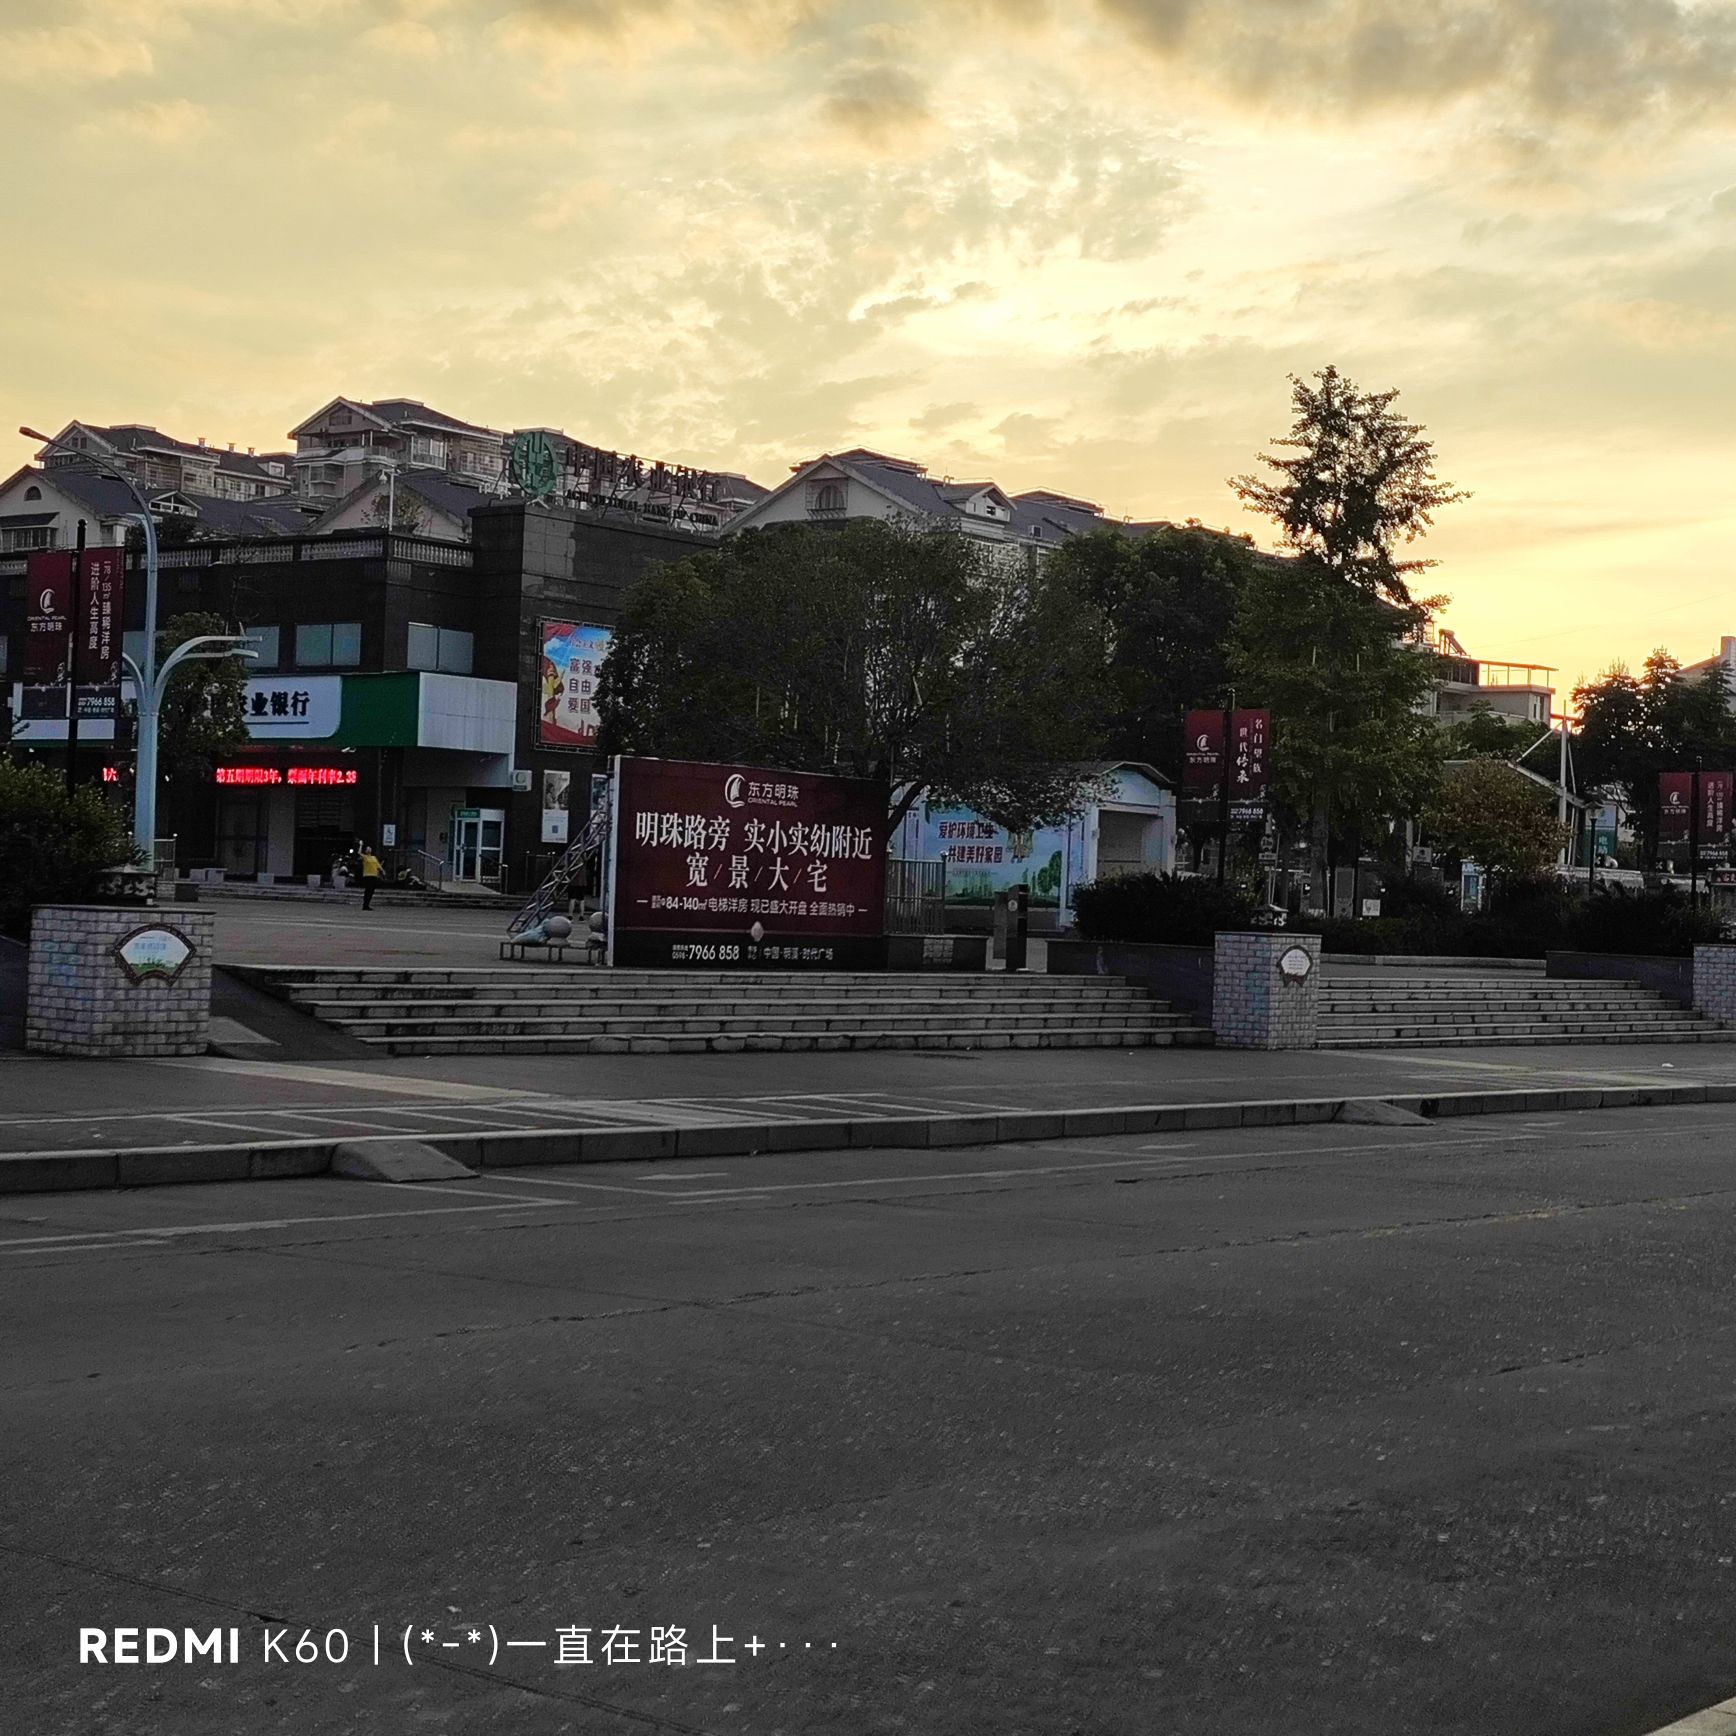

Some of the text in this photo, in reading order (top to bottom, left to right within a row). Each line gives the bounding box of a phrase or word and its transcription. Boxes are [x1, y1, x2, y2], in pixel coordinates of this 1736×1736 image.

[569, 678, 591, 693] 自由
[568, 697, 591, 713] 爱国
[748, 781, 799, 800] 东方明珠
[778, 800, 798, 808] PEARL
[635, 811, 731, 851] 明珠路旁
[743, 818, 873, 860] 实小实幼附近
[938, 821, 995, 840] 爱护环境卫生
[948, 845, 1003, 863] 共建美好家园
[750, 899, 807, 916] 现已盛大开盘
[809, 901, 855, 917] 全面热销中
[688, 944, 715, 961] 7966
[718, 945, 740, 961] 858
